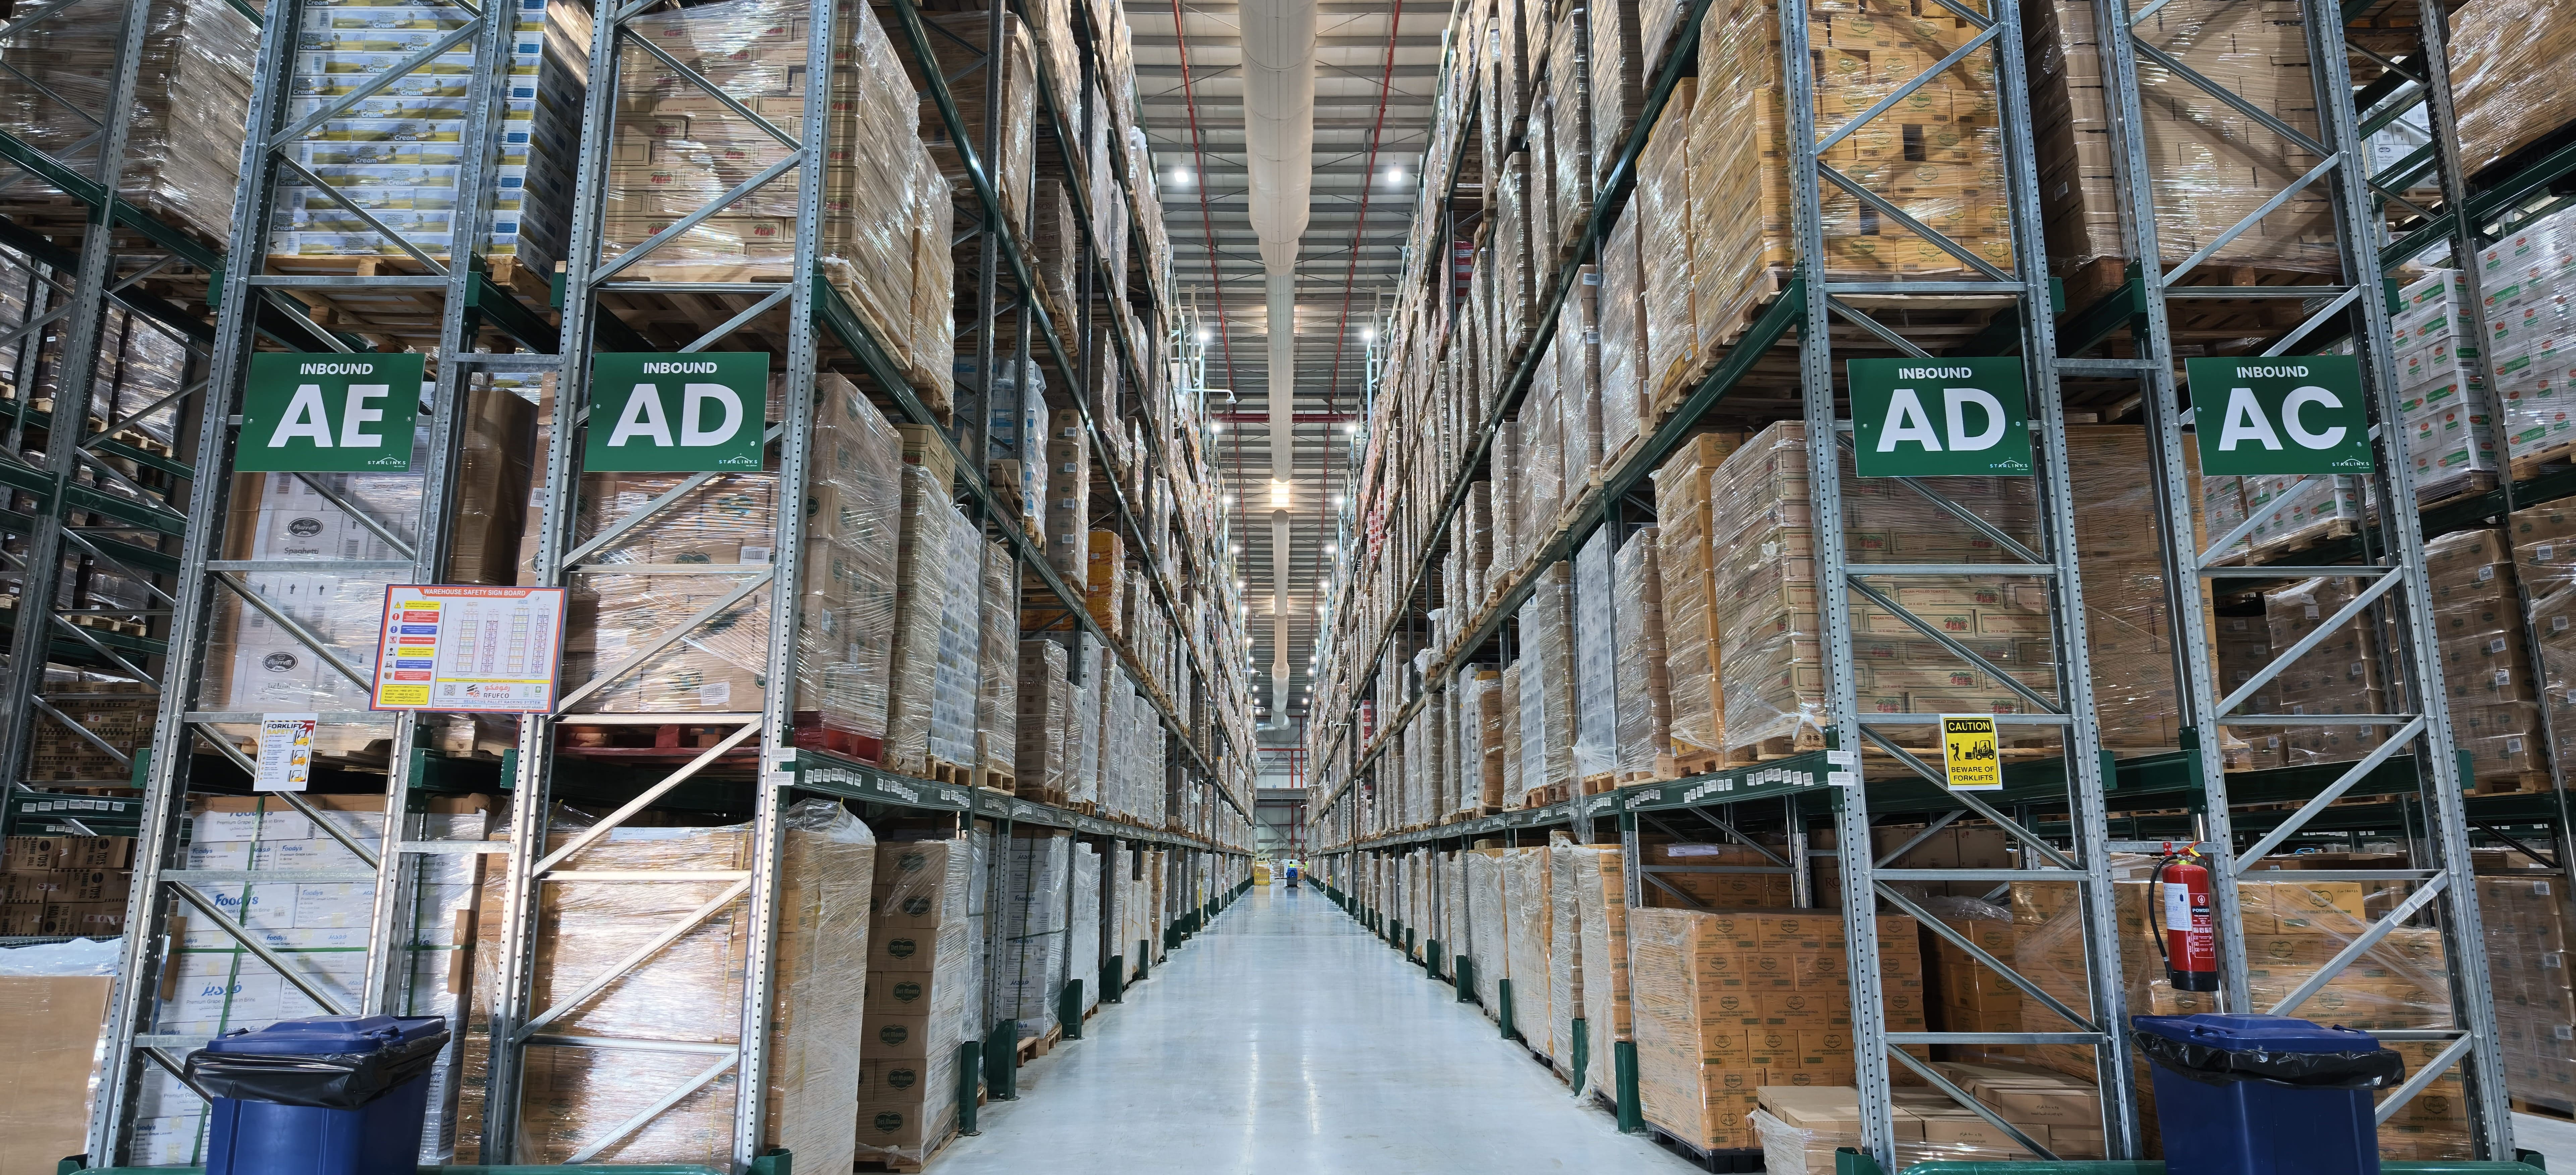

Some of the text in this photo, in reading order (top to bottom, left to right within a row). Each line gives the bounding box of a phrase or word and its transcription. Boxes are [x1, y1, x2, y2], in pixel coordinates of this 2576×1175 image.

[300, 363, 373, 375] INBOUND
[644, 362, 717, 374] INBOUND
[1899, 367, 1972, 379] INBOUND
[2237, 366, 2309, 378] INBOUND
[267, 384, 389, 447] AE
[607, 383, 743, 446] AD
[1876, 388, 2005, 452] AD
[2218, 386, 2347, 451] AC
[284, 547, 319, 555] Spaghetti
[1948, 722, 1990, 731] CAUTION
[37, 854, 49, 867] TOYS
[96, 852, 107, 865] TOYS
[89, 886, 101, 899] TOYS
[48, 905, 59, 918] TOYS
[160, 1027, 180, 1035] Foody's
